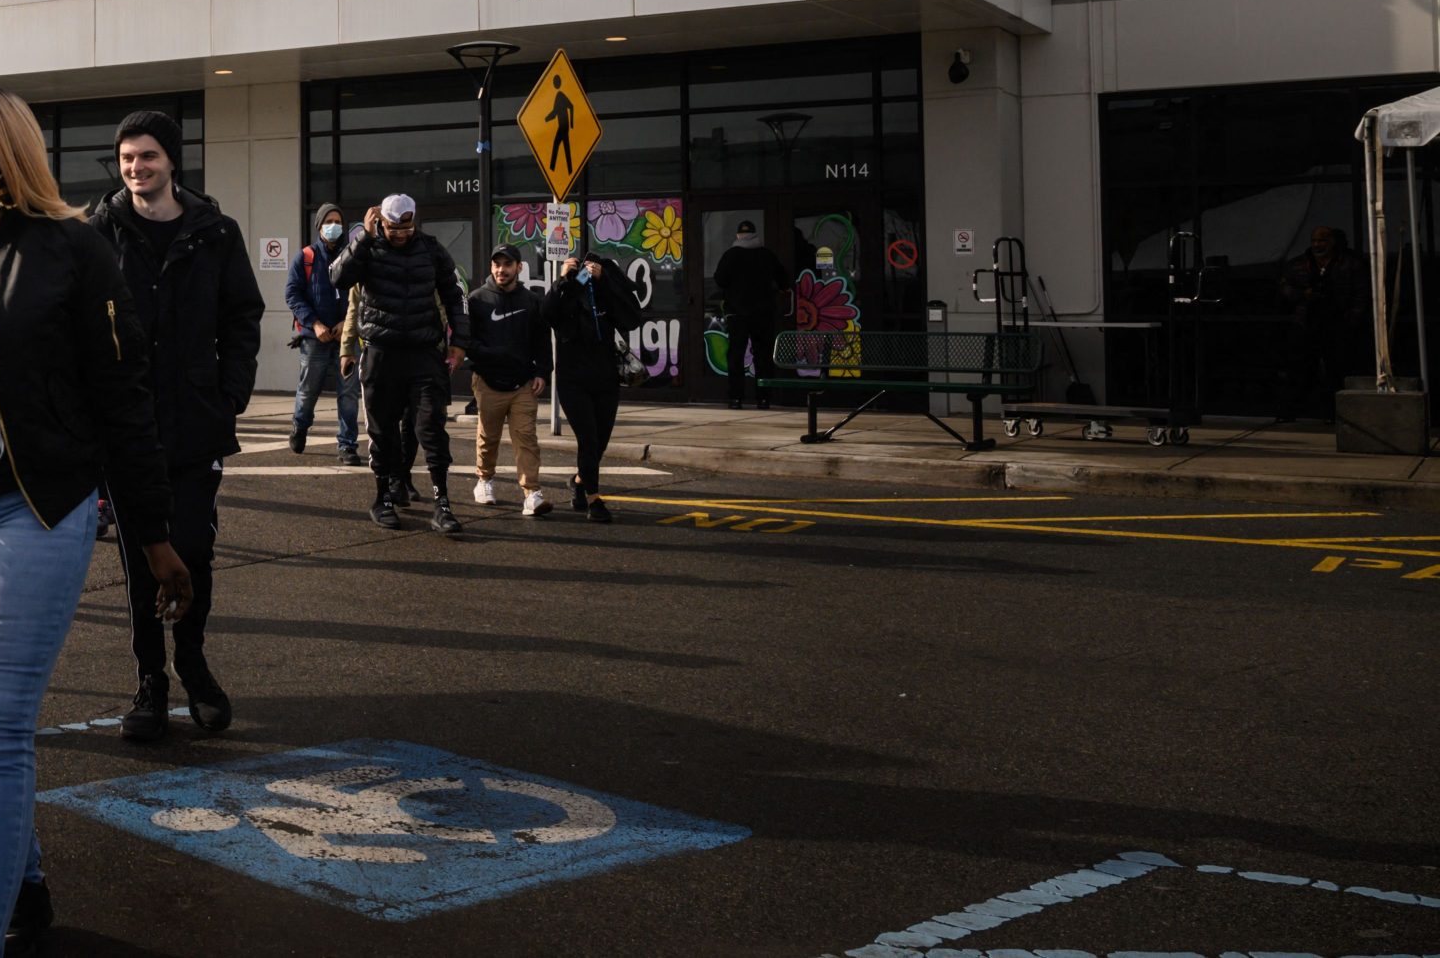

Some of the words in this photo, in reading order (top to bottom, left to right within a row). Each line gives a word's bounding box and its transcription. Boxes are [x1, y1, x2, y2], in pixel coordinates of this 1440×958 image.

[825, 163, 869, 179] N114
[446, 179, 480, 193] N113
[548, 247, 558, 255] BUS
[558, 247, 569, 255] STOP
[656, 512, 817, 533] NO
